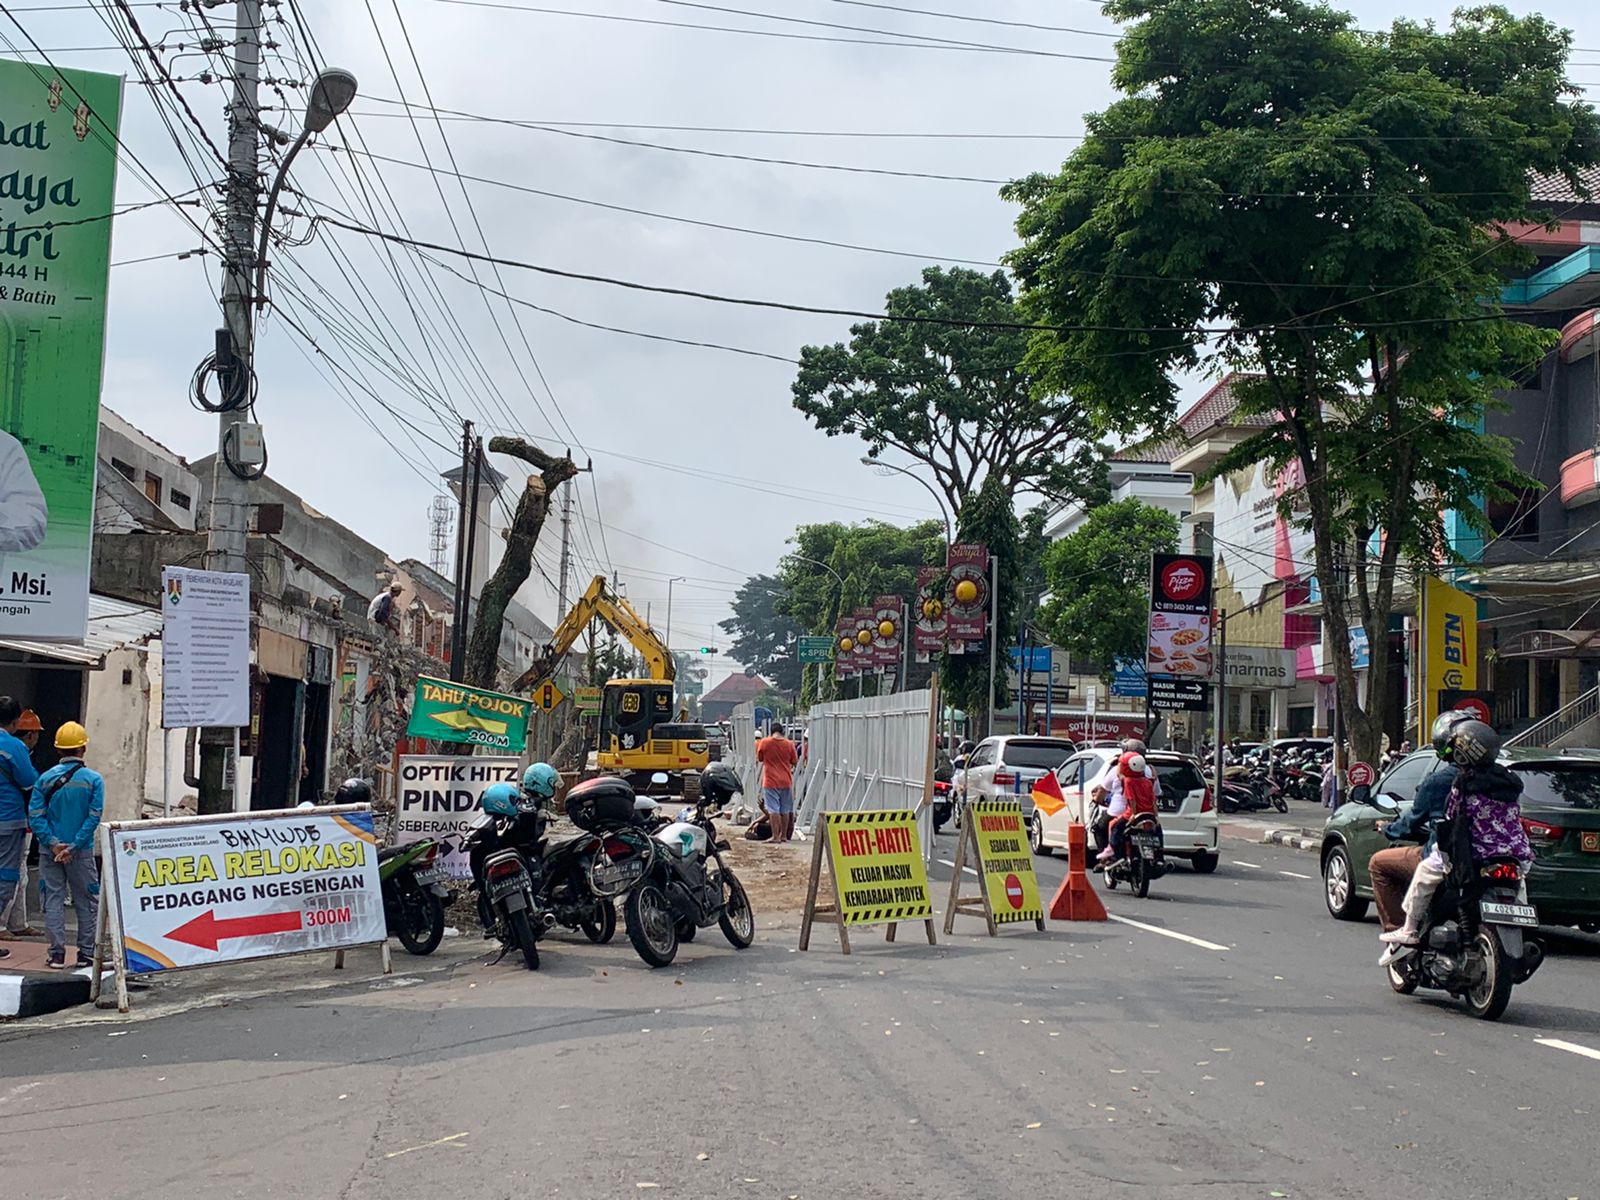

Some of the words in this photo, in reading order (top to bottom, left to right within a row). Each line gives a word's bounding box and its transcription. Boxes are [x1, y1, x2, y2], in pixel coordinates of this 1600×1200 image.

[0, 218, 60, 260] tri
[34, 266, 48, 282] H
[12, 287, 57, 306] Batin
[11, 571, 52, 596] Msi.
[1168, 576, 1194, 587] Pizza
[1172, 583, 1193, 593] Hut
[0, 605, 31, 616] ngah
[1444, 613, 1461, 664] BTN
[422, 684, 465, 703] TAHU
[468, 693, 524, 717] POJOK
[1152, 691, 1175, 699] PARKIR
[402, 765, 465, 782] OPTIK
[470, 765, 518, 782] HITZ
[398, 820, 469, 833] SEBERANG
[838, 827, 912, 857] HATI-HATI!
[133, 854, 218, 889] AREA
[224, 841, 366, 879] RELOKASI
[850, 866, 882, 883] KELUAR
[882, 864, 912, 881] MASUK
[141, 886, 246, 912] PEDAGANG
[252, 874, 365, 899] NGESENGAN
[844, 888, 894, 907] KENDARAAN
[894, 885, 925, 903] PROYEK
[305, 907, 351, 927] 300M
